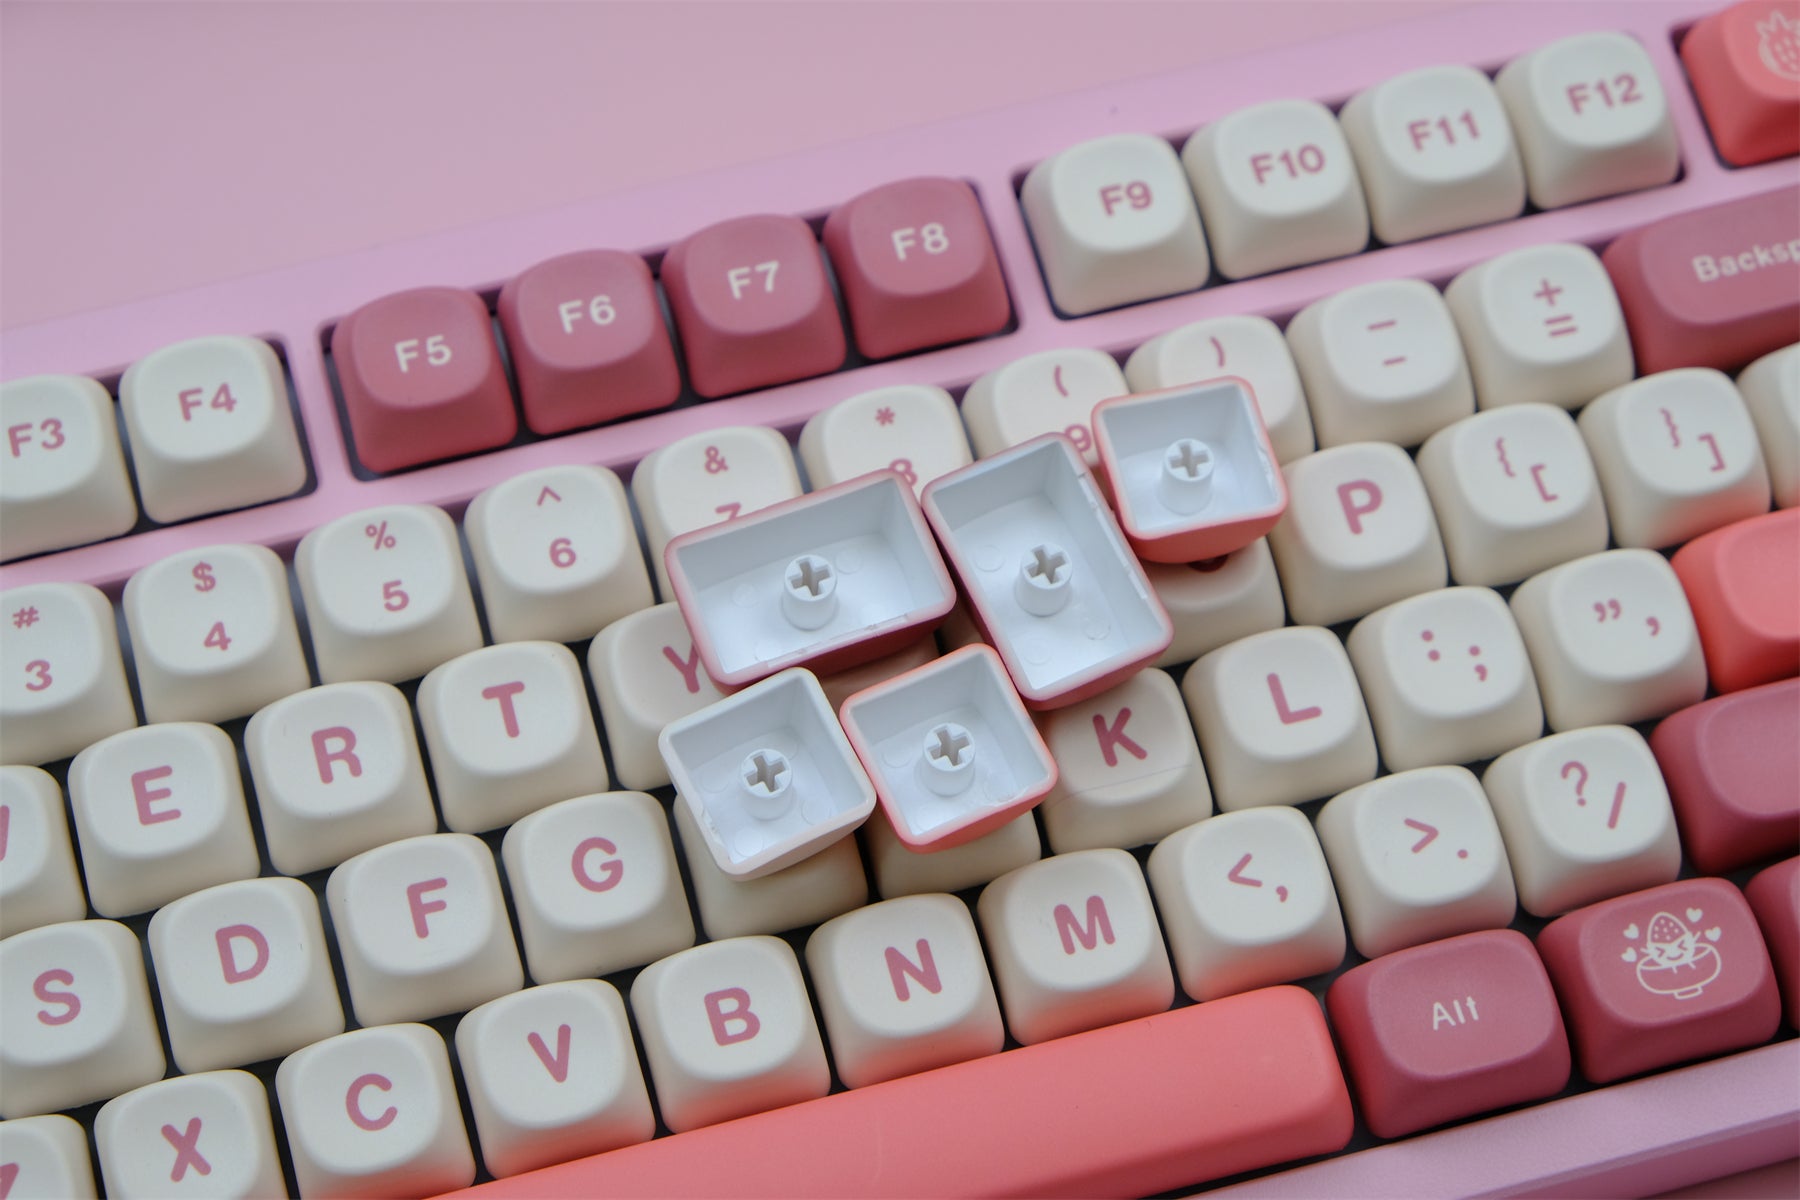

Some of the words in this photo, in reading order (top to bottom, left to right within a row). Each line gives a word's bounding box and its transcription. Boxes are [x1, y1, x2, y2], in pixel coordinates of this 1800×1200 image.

[1567, 74, 1641, 113] F12
[1408, 112, 1478, 150] F11
[1250, 144, 1325, 184] F10
[1100, 182, 1152, 216] F9
[892, 223, 948, 260] F8
[728, 261, 779, 299] F7
[560, 295, 616, 333] F6
[395, 335, 452, 372] F5
[179, 384, 236, 421] F4
[8, 419, 64, 457] F3
[1064, 424, 1092, 452] 9
[1338, 480, 1382, 534] P
[550, 538, 576, 568] 6
[383, 580, 409, 612] 5
[204, 622, 232, 650] 4
[26, 660, 52, 691] 3
[662, 638, 701, 694] Y
[483, 682, 524, 738] T
[1268, 673, 1322, 724] L
[312, 726, 362, 784] R
[1092, 707, 1147, 767] K
[131, 766, 181, 825] E
[571, 837, 623, 892] G
[407, 877, 447, 938] F
[1054, 896, 1115, 954] M
[215, 924, 270, 983] D
[885, 939, 942, 1001] N
[33, 969, 81, 1025] S
[704, 987, 760, 1046] B
[1433, 997, 1478, 1030] Alt
[528, 1024, 571, 1082] V
[346, 1073, 397, 1131] C
[162, 1118, 211, 1181] X
